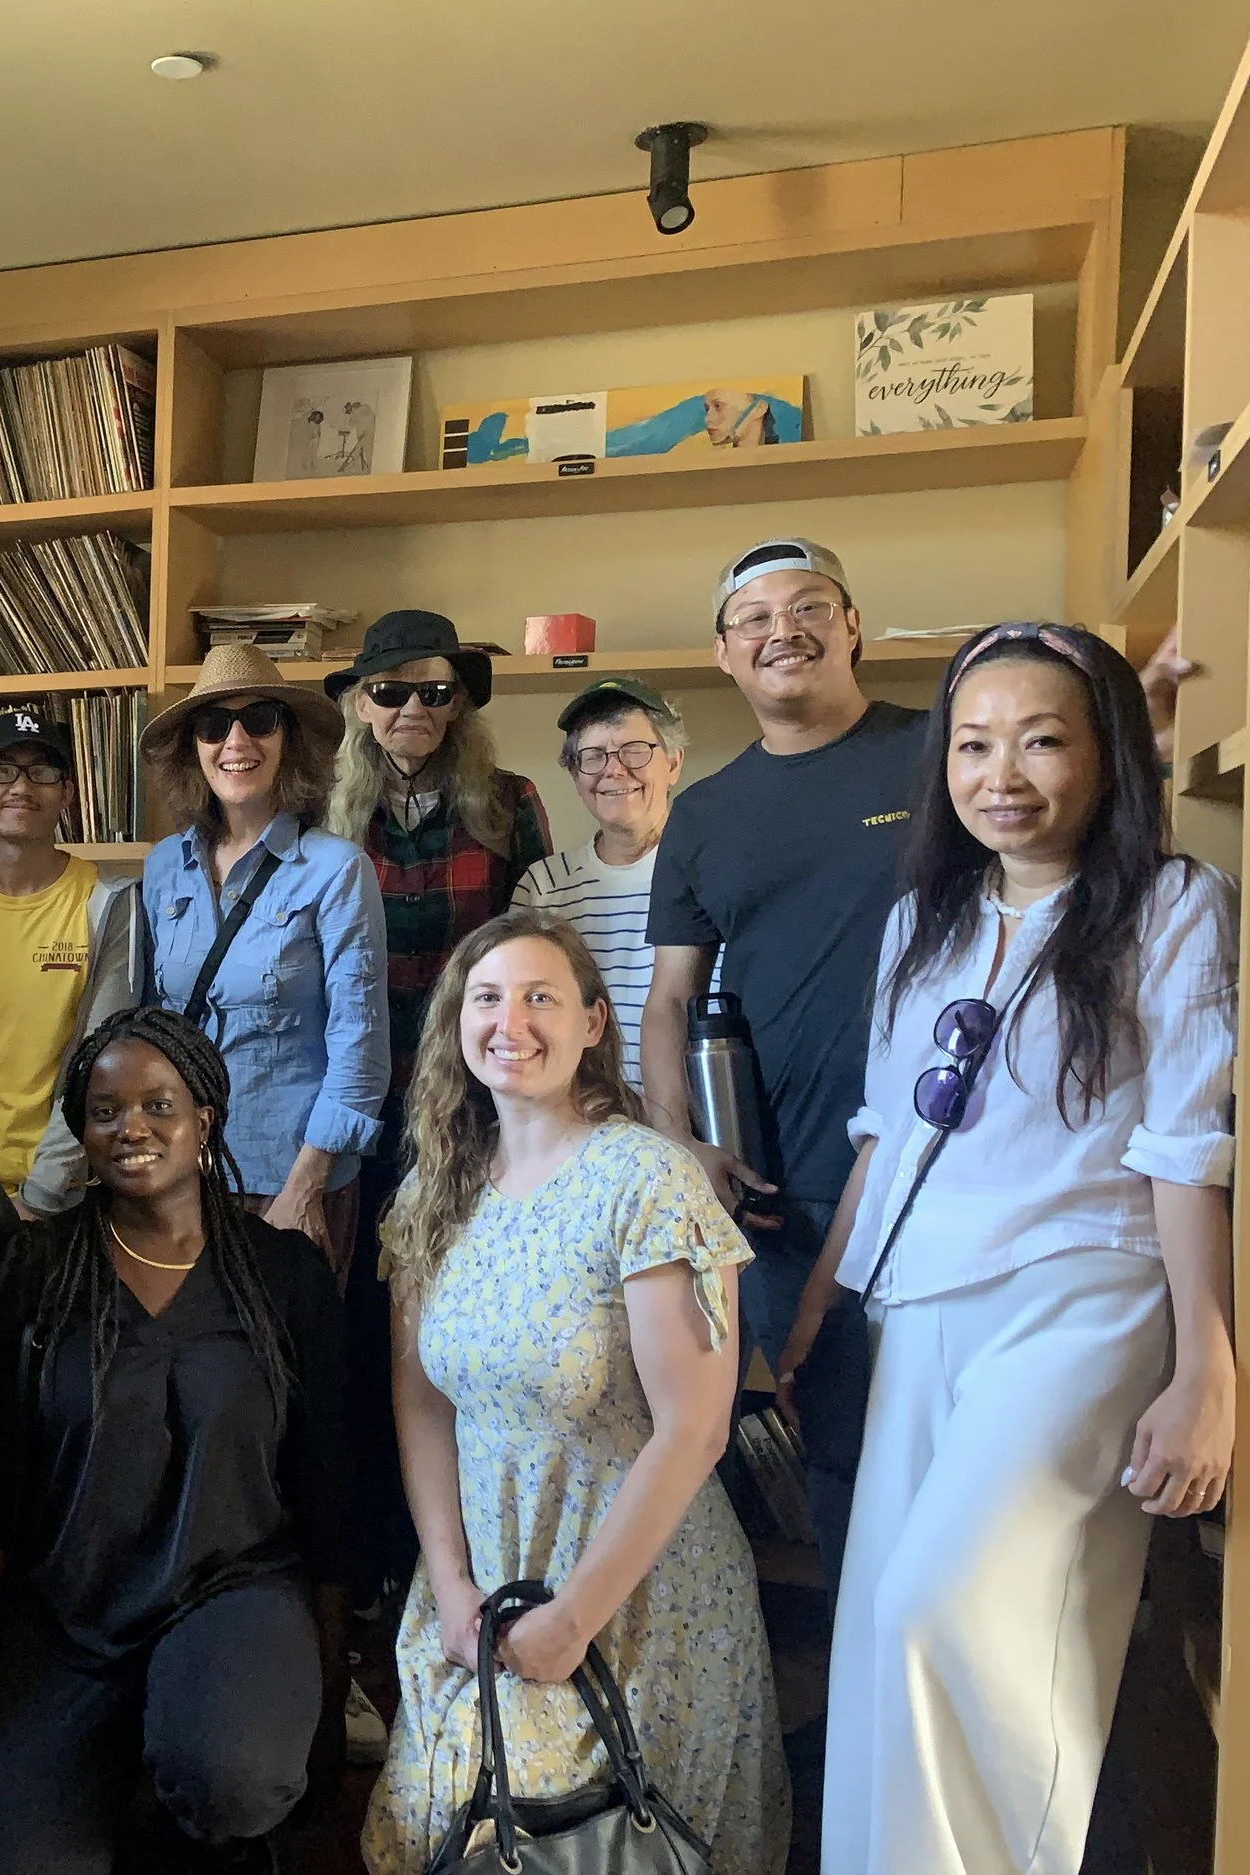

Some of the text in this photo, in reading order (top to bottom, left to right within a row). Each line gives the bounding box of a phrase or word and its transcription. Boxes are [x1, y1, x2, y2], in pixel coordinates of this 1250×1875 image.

[868, 362, 1021, 404] everything
[15, 713, 40, 733] LA
[52, 942, 73, 951] 2018
